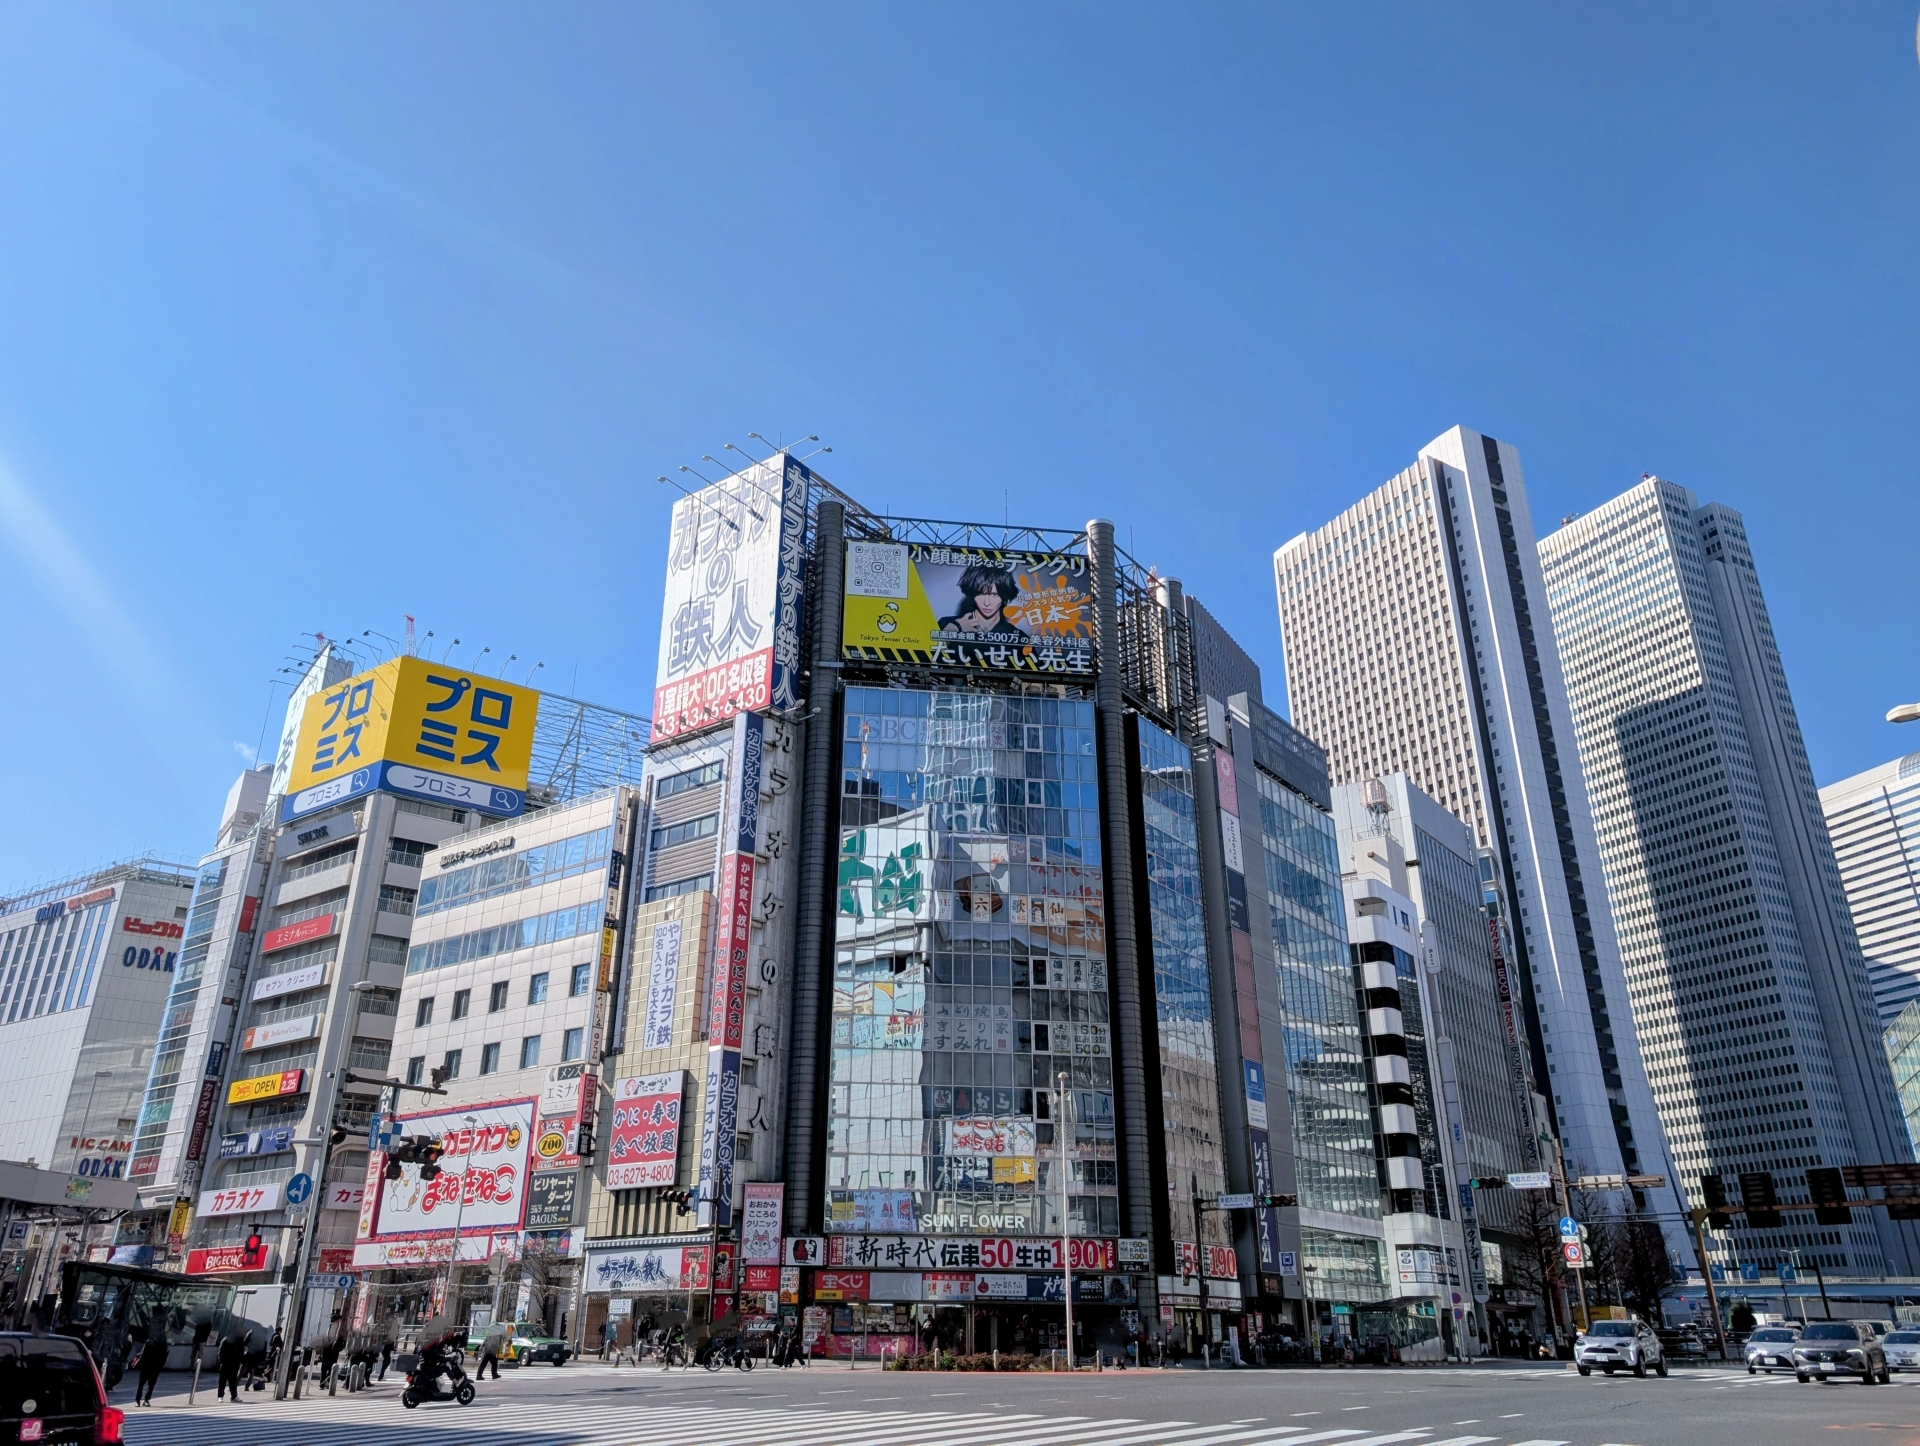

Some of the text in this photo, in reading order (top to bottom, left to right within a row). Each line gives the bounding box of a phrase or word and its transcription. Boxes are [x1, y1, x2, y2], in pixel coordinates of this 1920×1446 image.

[670, 462, 782, 577] カラオケ
[706, 548, 734, 598] の
[910, 546, 1086, 578] 小顔整形ならテンクリ
[772, 464, 808, 707] カラオケの鉄人
[667, 578, 764, 678] 鉄人
[1026, 604, 1089, 627] 日本一
[860, 634, 920, 644] Tokyo Tensei Clinic
[930, 642, 1093, 673] たいせい先生
[658, 654, 768, 718] 1室最大100名収容
[321, 678, 375, 732] プロ
[426, 674, 513, 730] プロ
[311, 722, 364, 773] ミス
[415, 718, 501, 772] ミス
[307, 783, 341, 806] プロミス
[414, 775, 472, 799] プロミス
[740, 728, 762, 838] カラオケの鉄人
[719, 861, 733, 939] かに食べ放題
[736, 861, 750, 941] かに食べ放題
[1488, 918, 1502, 957] NOAダンス
[265, 970, 318, 992] セブン クリニック
[656, 923, 680, 1045] やっぱりカラ鉄
[934, 1035, 992, 1050] すみれ
[1504, 1010, 1516, 1044] NOAダンス
[254, 1079, 277, 1094] OPEN
[281, 1079, 297, 1091] 2.25
[559, 1065, 584, 1079] メンズ
[198, 1083, 214, 1118] カラオケ
[581, 1078, 596, 1120] カラオケ
[614, 1100, 679, 1128] かに・寿司
[443, 1124, 511, 1157] カラオケ
[541, 1139, 562, 1150] ZOO
[612, 1129, 676, 1158] 食べ放題
[700, 1071, 718, 1200] カラオケの鉄人
[716, 1070, 738, 1206] カラオケの鉄人
[420, 1163, 517, 1214] まねきねこ
[533, 1175, 575, 1191] ビリヤード
[608, 1164, 674, 1186] 03-6279-4800
[1510, 1174, 1548, 1182] 新宿大ガード西
[211, 1189, 265, 1211] カラオケ
[547, 1190, 573, 1204] ダーツ
[173, 1208, 184, 1234] OPEN
[530, 1213, 558, 1225] BAGUS
[746, 1220, 778, 1228] クリニック
[748, 1210, 777, 1218] こころの
[922, 1214, 1026, 1229] SUN FLOWER
[855, 1235, 937, 1268] 新時代
[940, 1243, 980, 1267] 伝串
[1015, 1246, 1052, 1269] 生中
[1106, 1241, 1114, 1258] 2F
[1210, 1246, 1236, 1278] 190
[1467, 1228, 1481, 1270] ウインザー
[597, 1254, 671, 1285] カラオケの鉄人
[749, 1269, 771, 1279] SBC
[822, 1274, 864, 1288] 宝くじ
[569, 1270, 579, 1311] BAGUS
